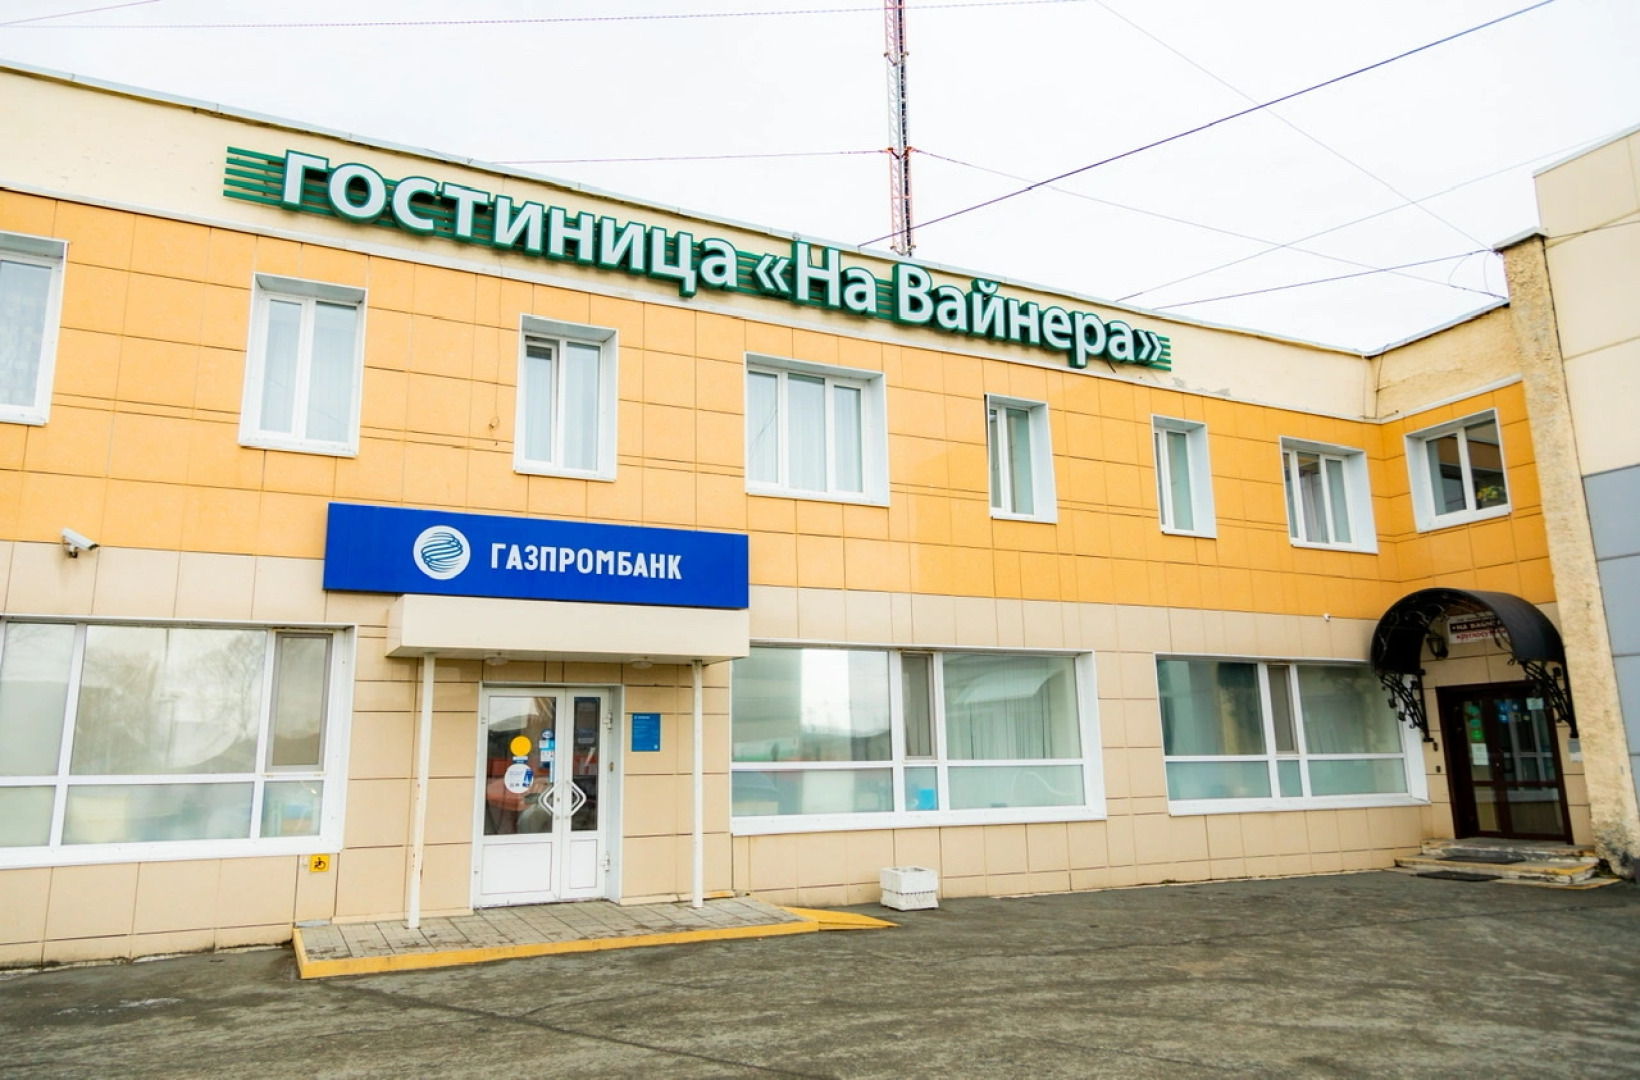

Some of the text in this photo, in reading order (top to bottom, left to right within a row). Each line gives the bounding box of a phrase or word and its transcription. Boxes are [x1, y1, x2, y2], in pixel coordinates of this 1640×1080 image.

[753, 241, 878, 313] «На
[893, 262, 1163, 367] Вайнера»
[490, 542, 682, 580] ГАЗПРОМБАНК
